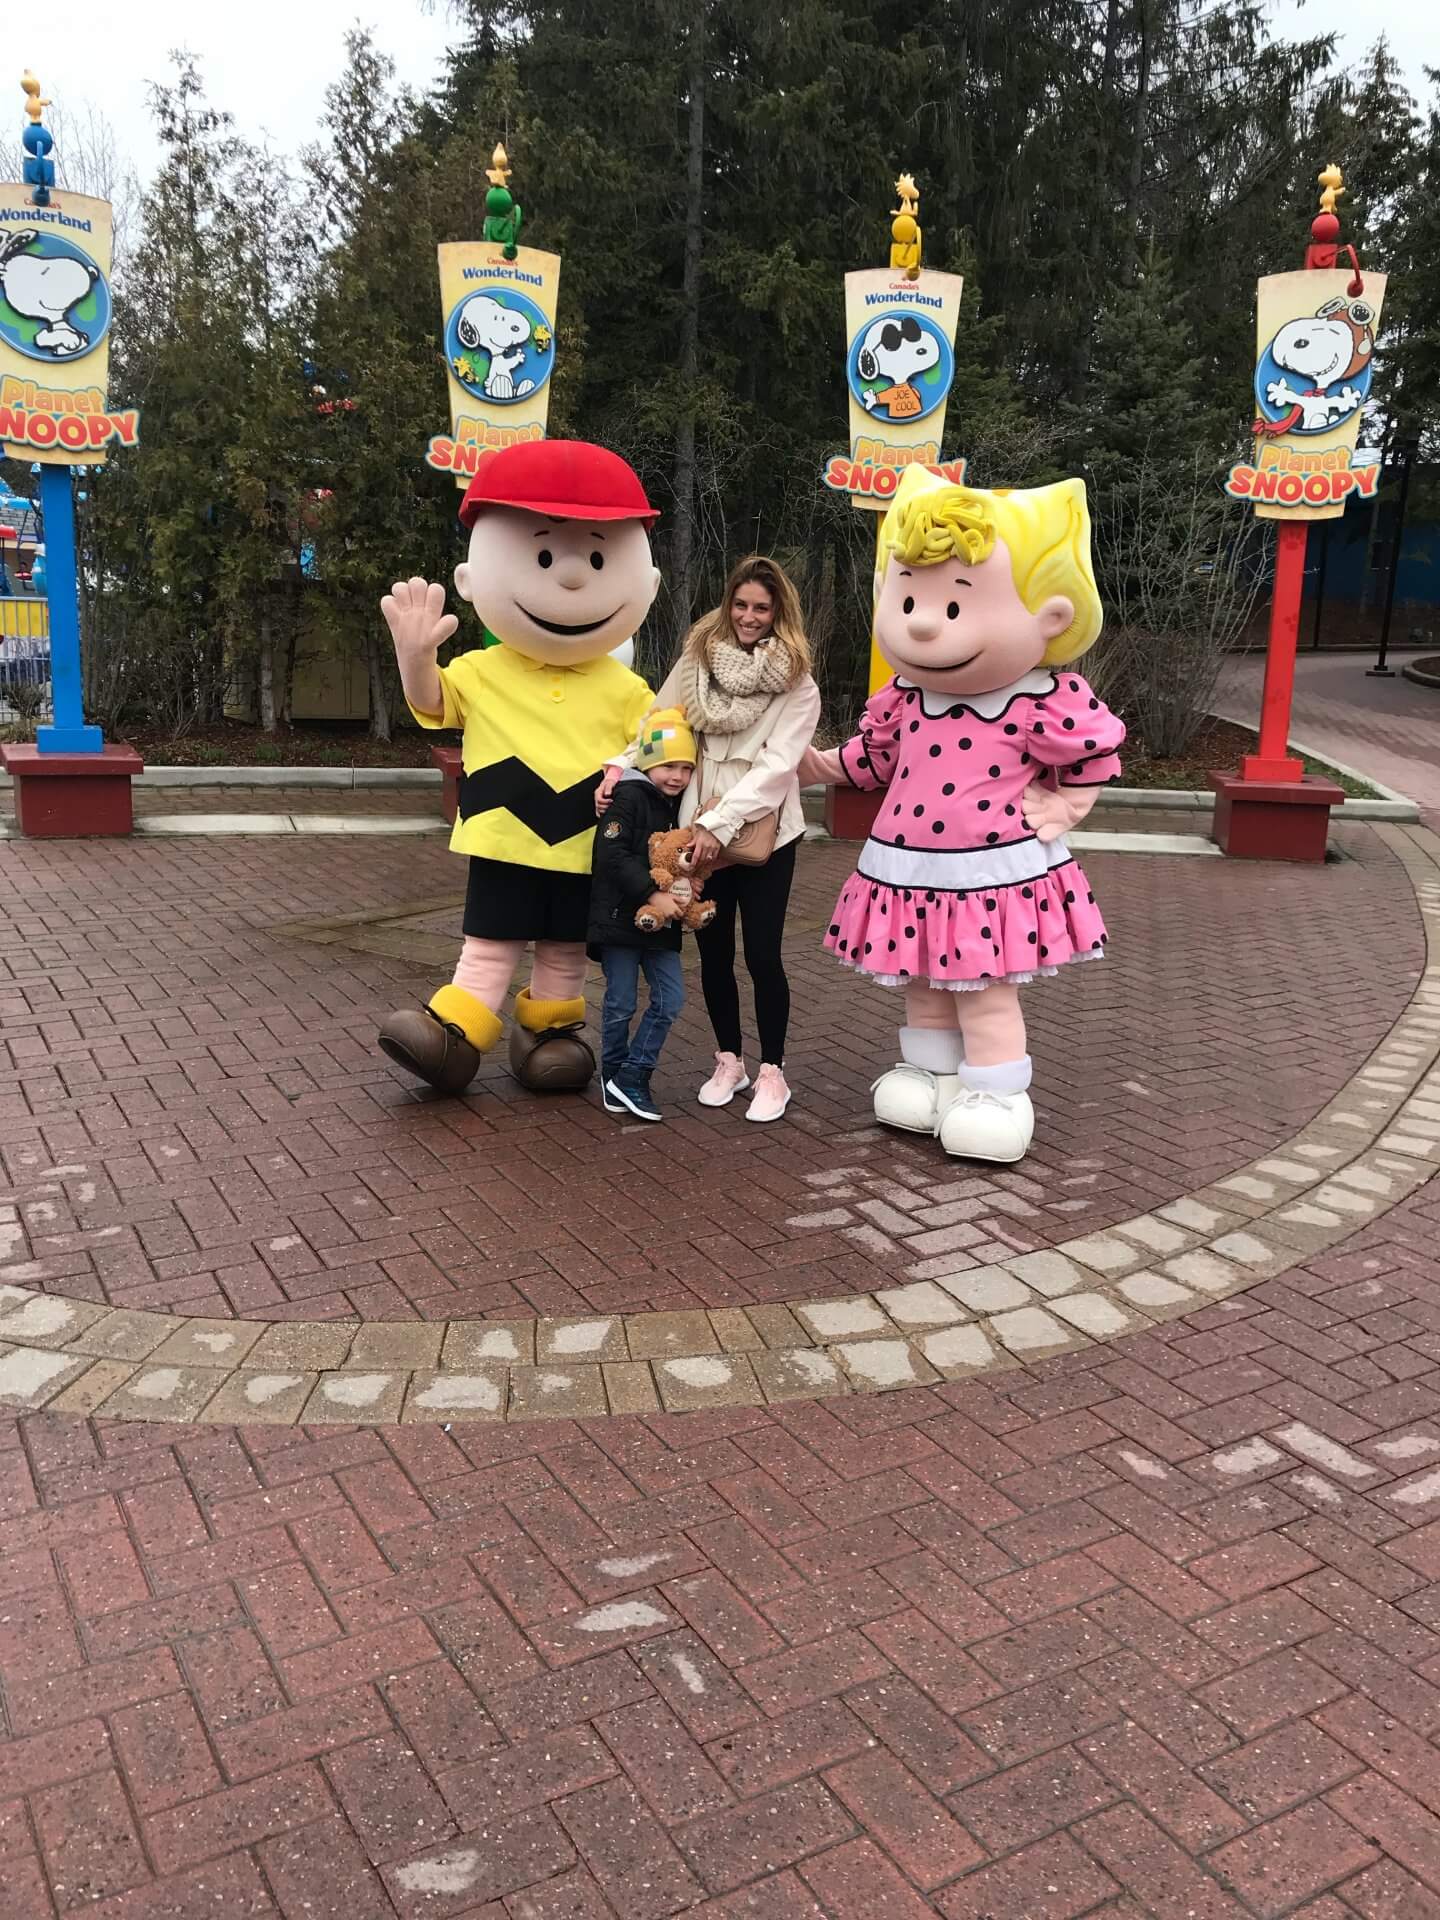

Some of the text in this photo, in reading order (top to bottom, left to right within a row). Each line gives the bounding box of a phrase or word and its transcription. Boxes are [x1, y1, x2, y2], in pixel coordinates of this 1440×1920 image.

[0, 208, 92, 232] Wonderland
[463, 266, 543, 287] Wonderland
[865, 290, 943, 309] Wonderland
[2, 378, 103, 414] Planet
[894, 389, 910, 400] JOE
[896, 401, 917, 411] COOL
[0, 406, 136, 447] NOOPY
[856, 439, 937, 466] Planet
[1260, 446, 1348, 472] Planet
[827, 459, 963, 495] SNOY
[1228, 464, 1378, 503] SNOOPY
